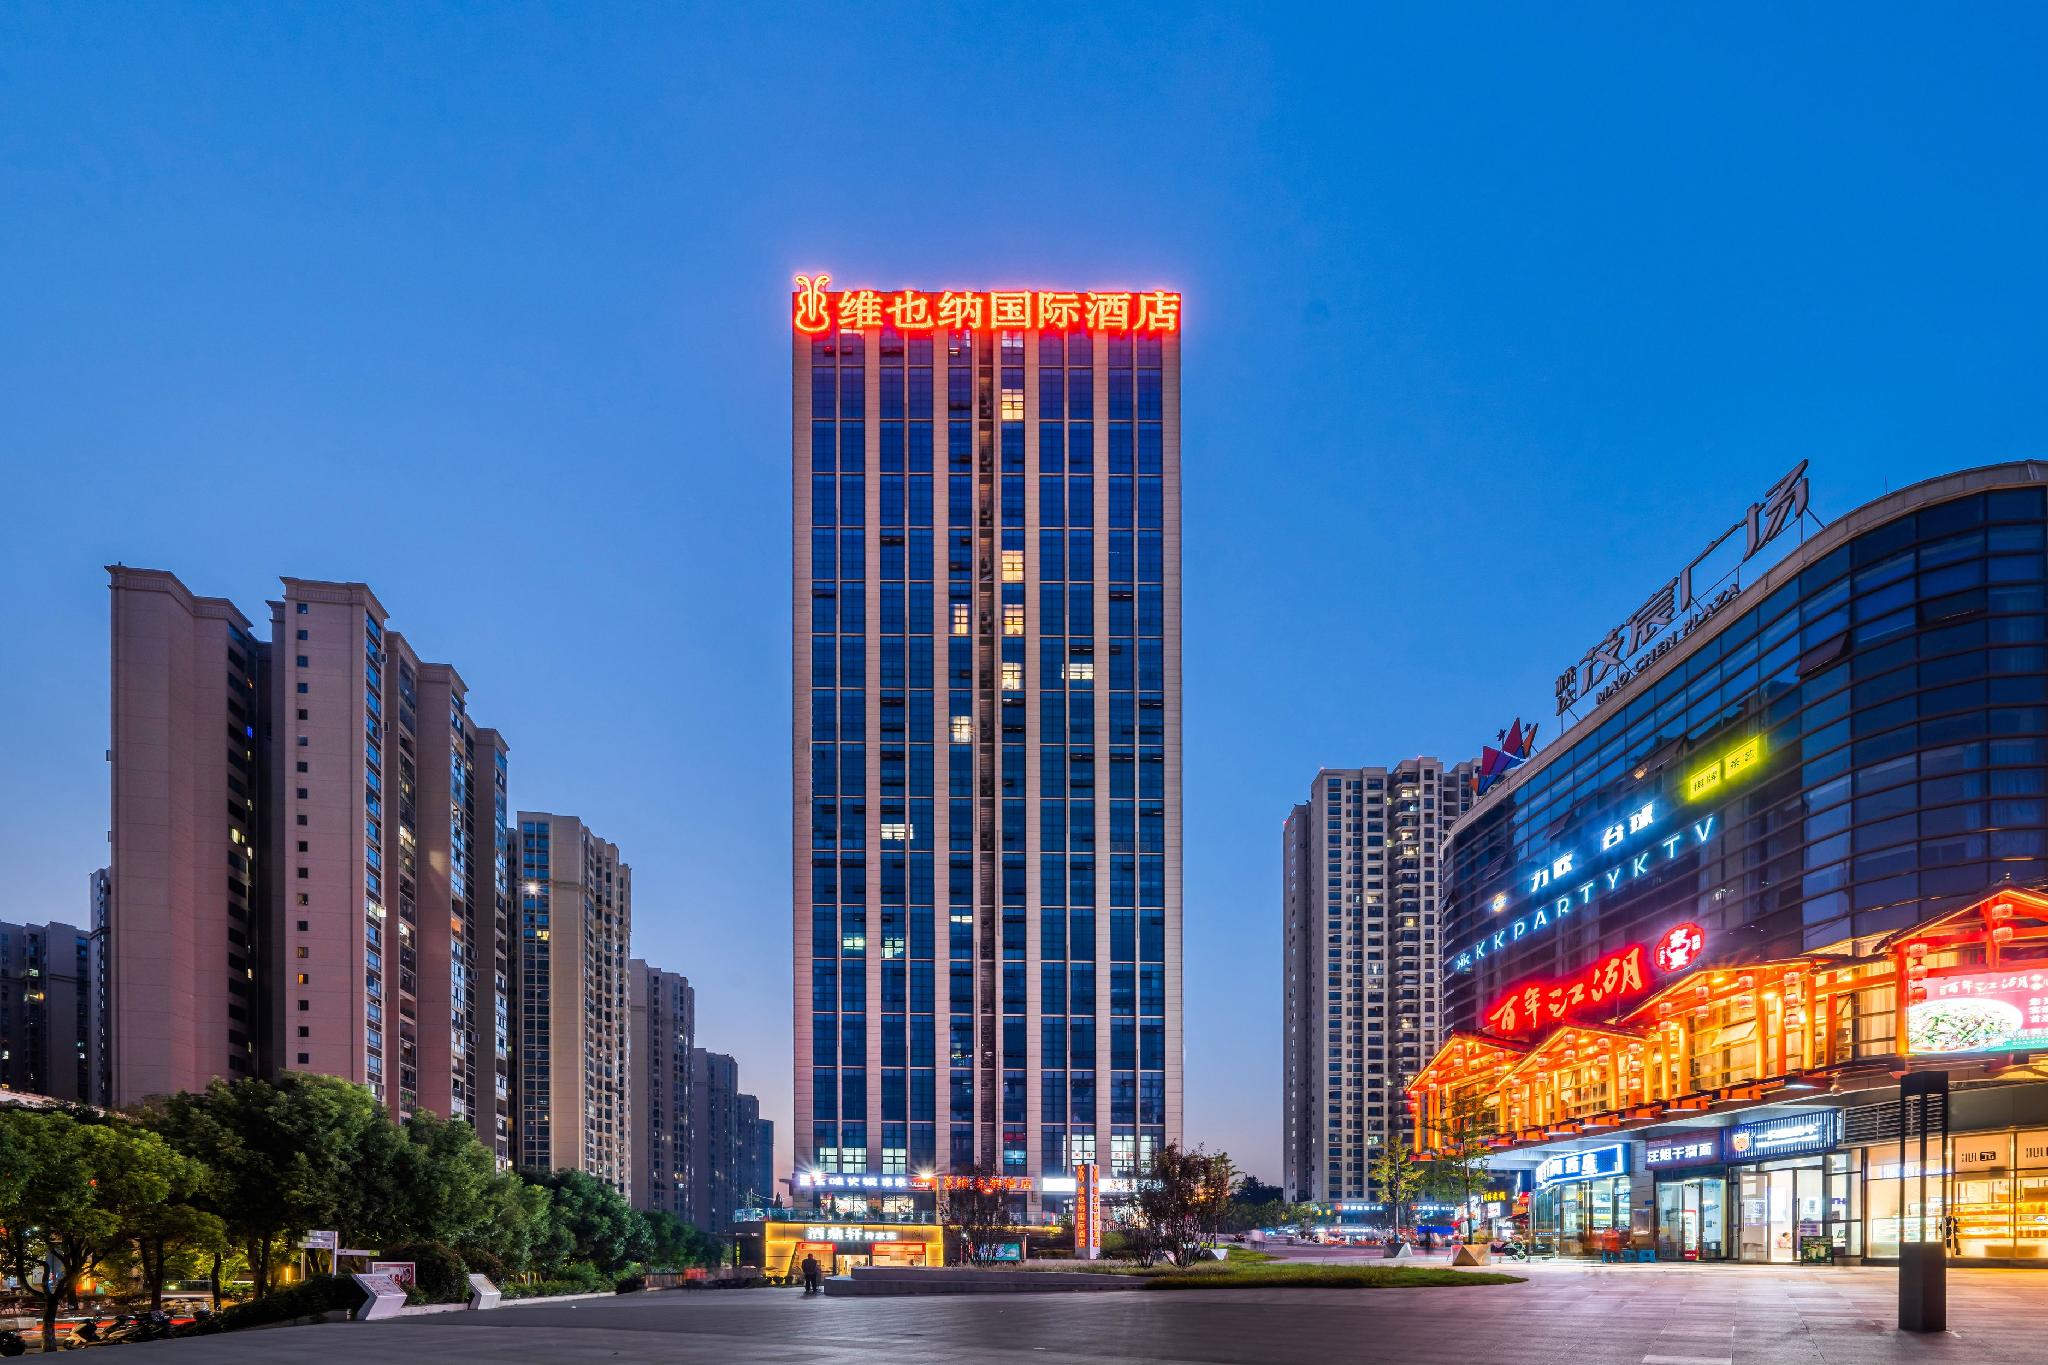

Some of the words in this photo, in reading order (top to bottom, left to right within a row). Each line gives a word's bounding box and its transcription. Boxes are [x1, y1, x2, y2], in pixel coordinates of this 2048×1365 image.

[838, 290, 1180, 331] 维也纳国际酒店
[1489, 947, 1643, 1031] 百年江湖
